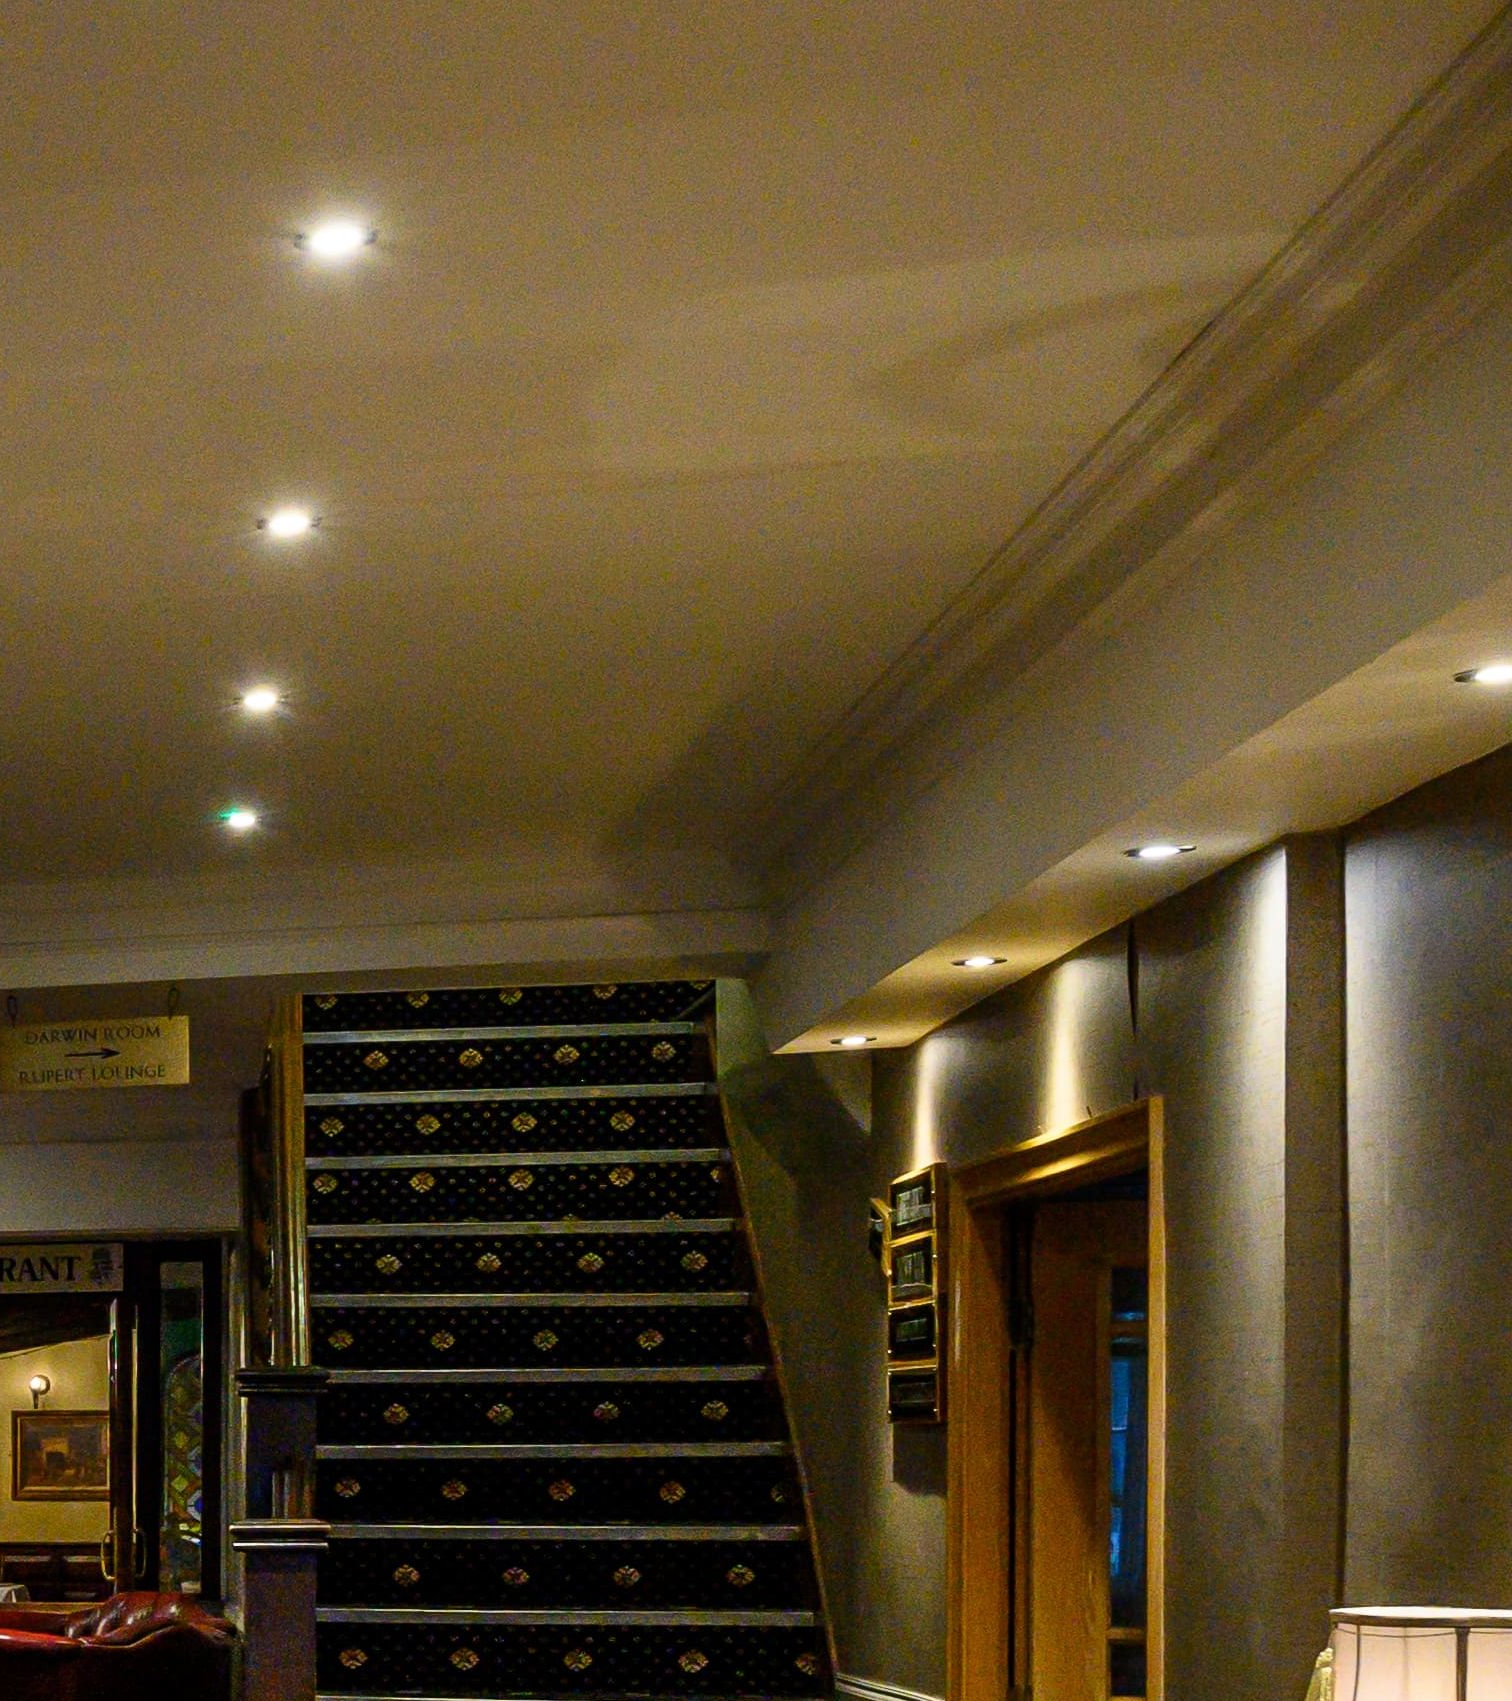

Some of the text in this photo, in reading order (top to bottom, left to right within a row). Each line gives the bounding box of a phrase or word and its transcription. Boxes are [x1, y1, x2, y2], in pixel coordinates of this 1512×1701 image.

[25, 1025, 161, 1045] DARWIN ROOM
[19, 1064, 166, 1084] RUPERT LOUNGE
